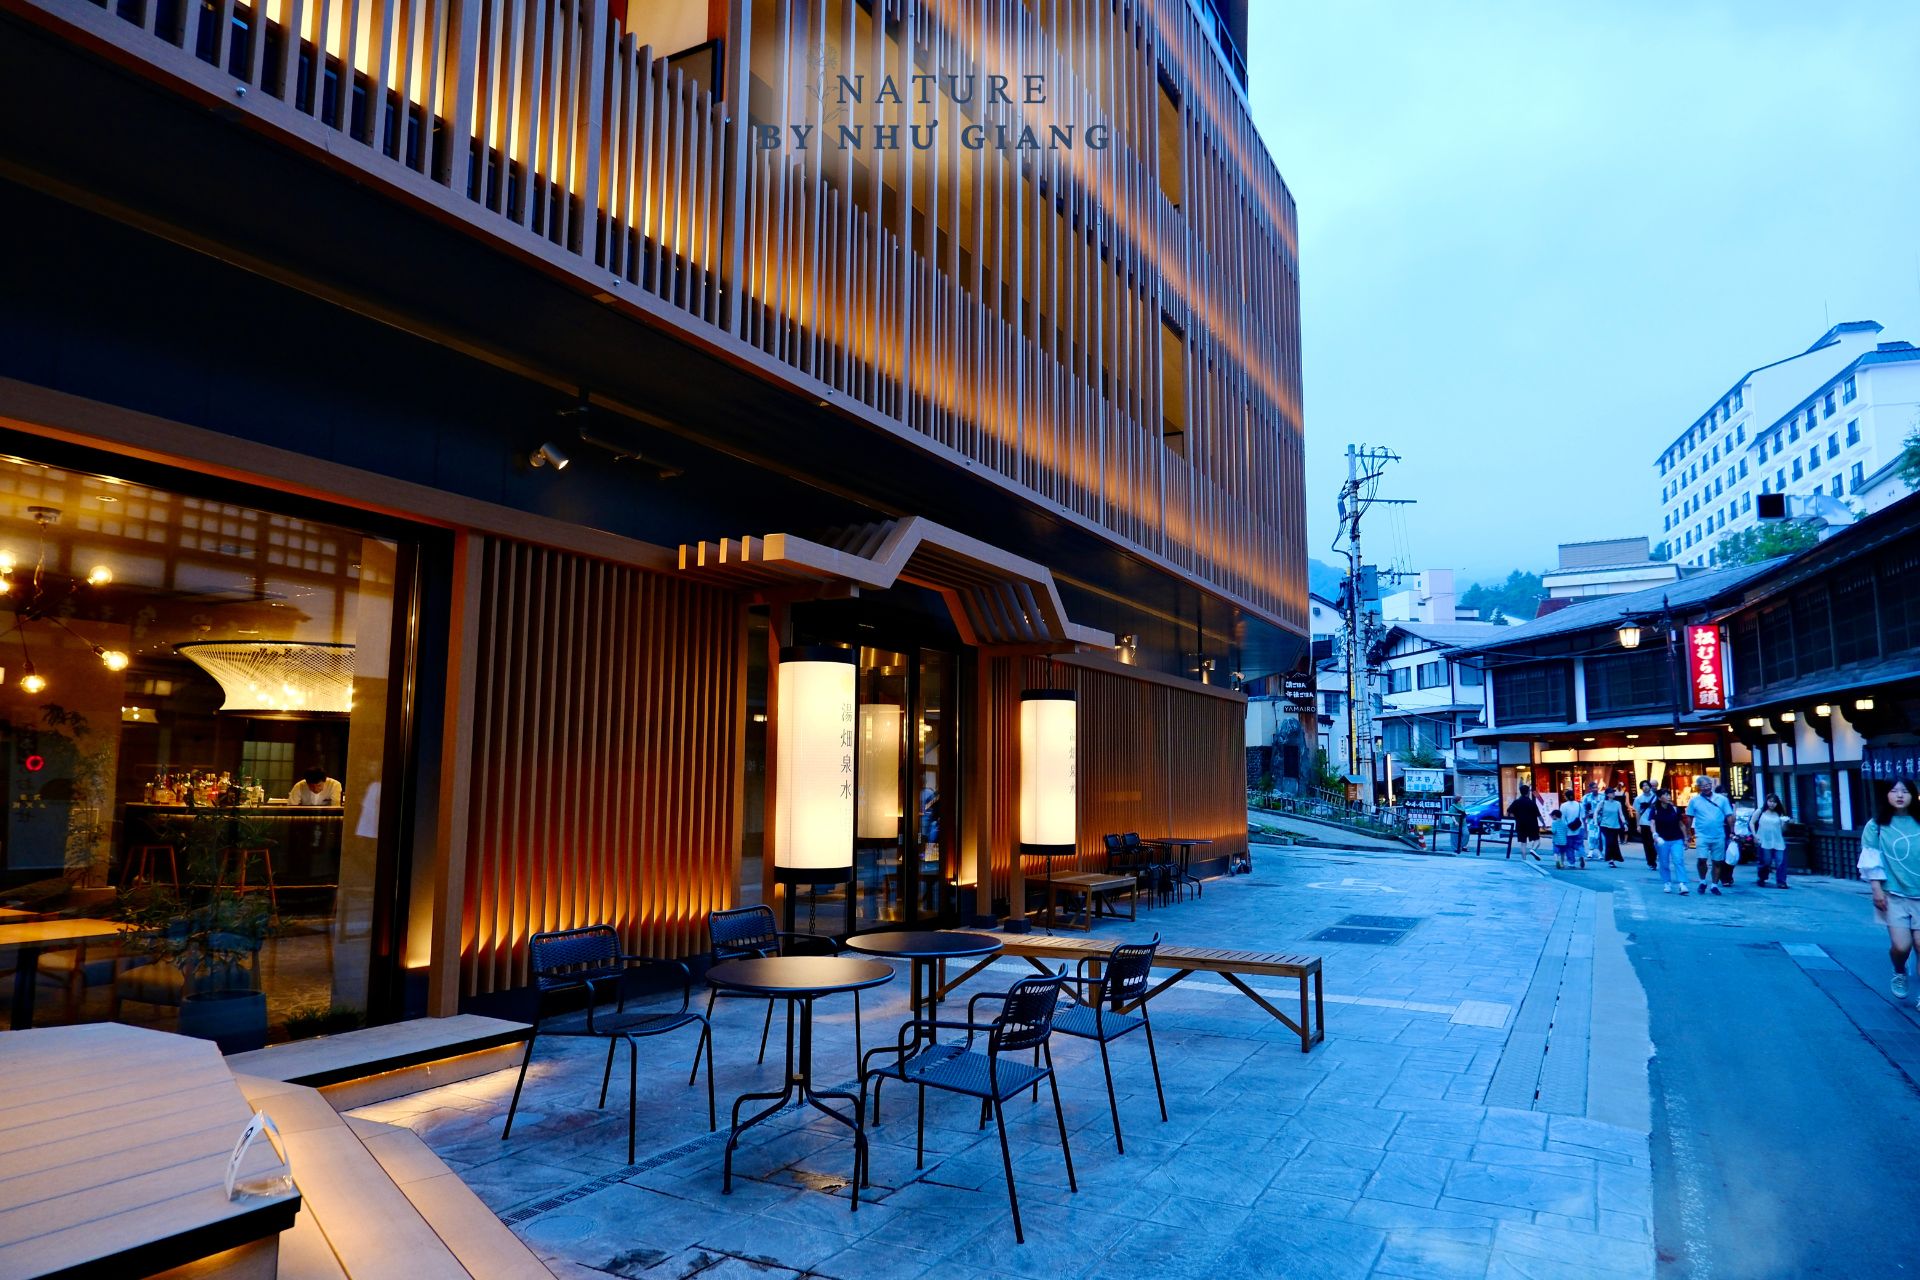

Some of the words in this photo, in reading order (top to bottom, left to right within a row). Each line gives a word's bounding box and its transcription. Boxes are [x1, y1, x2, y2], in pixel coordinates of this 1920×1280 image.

[1693, 628, 1720, 705] 松むら饅頭
[840, 703, 853, 800] 湯畑泉水
